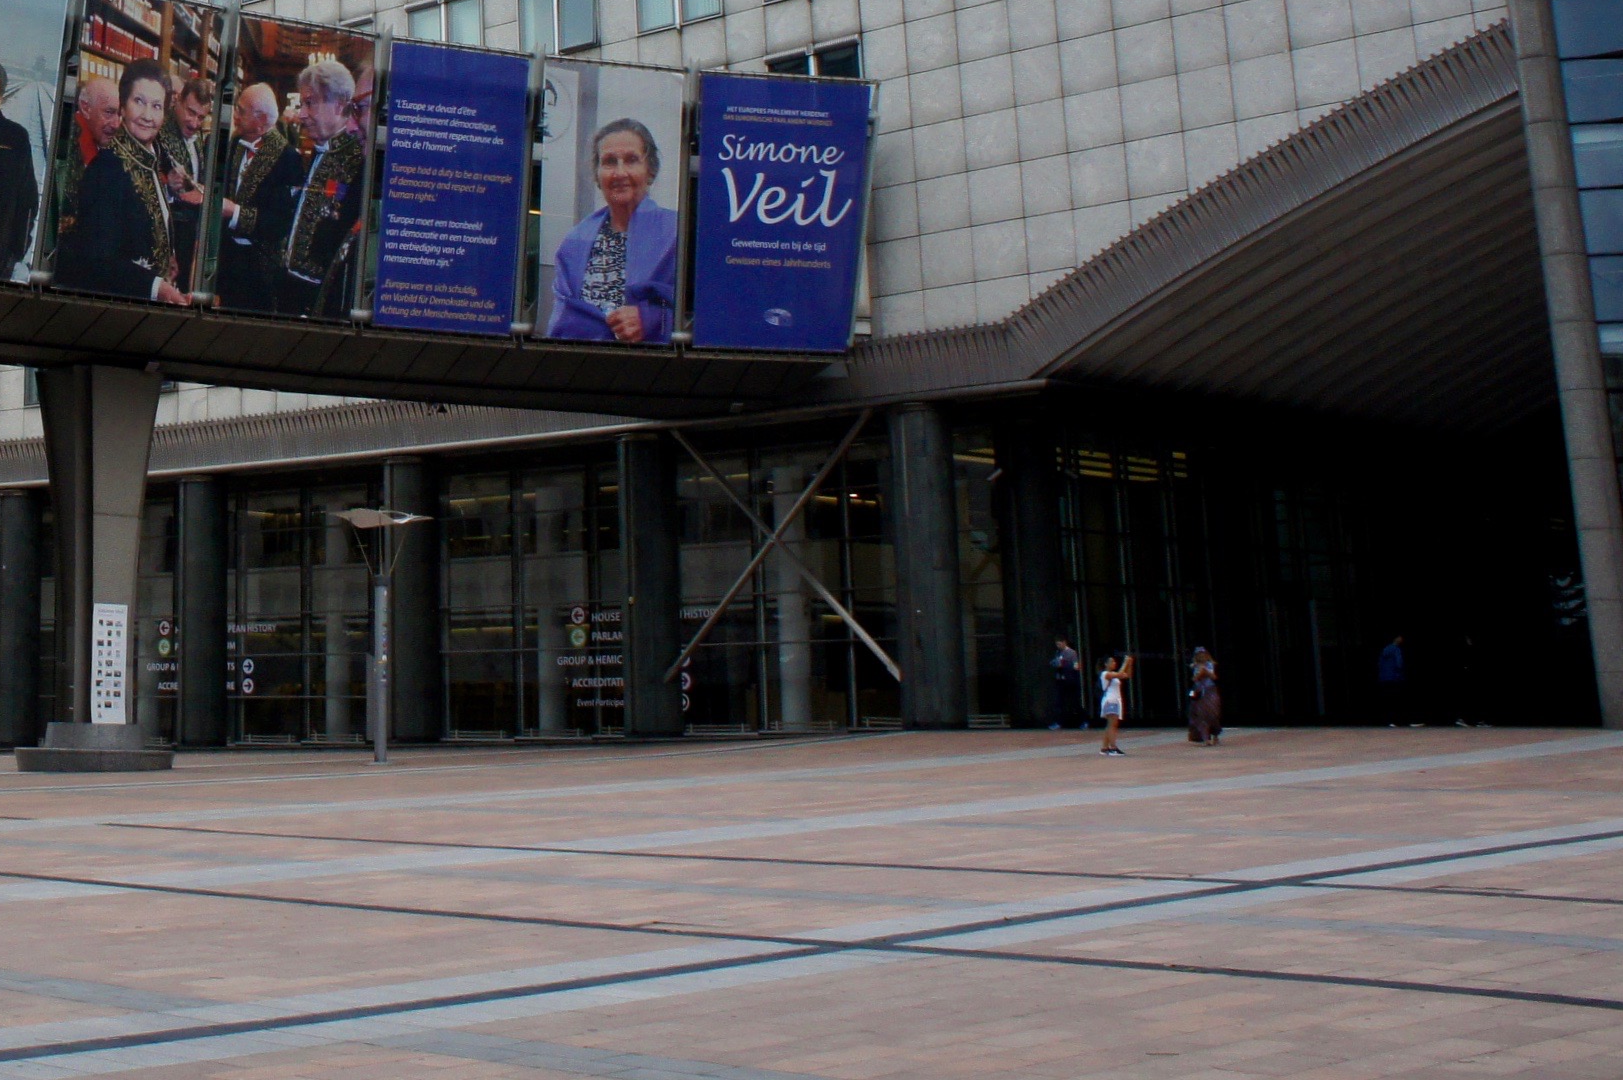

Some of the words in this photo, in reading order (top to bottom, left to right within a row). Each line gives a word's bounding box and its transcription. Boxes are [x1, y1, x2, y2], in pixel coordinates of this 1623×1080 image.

[435, 104, 456, 113] devait
[393, 114, 448, 125] exemplairement
[393, 127, 447, 138] exemplairement
[449, 133, 491, 143] respectueuse
[492, 137, 504, 145] des
[392, 139, 411, 148] droits
[412, 140, 421, 149] de
[718, 134, 845, 168] Simone
[417, 166, 432, 175] had
[438, 168, 454, 178] duty
[454, 170, 462, 178] to
[463, 170, 472, 179] be
[389, 176, 398, 184] of
[398, 177, 435, 189] democracy
[436, 182, 451, 190] and
[451, 184, 475, 192] respect
[388, 189, 414, 199] human
[721, 167, 853, 227] Veil
[415, 218, 434, 226] moet
[448, 221, 482, 230] toonbeeld
[400, 229, 438, 239] democratie
[463, 235, 496, 244] toonbeeld
[399, 243, 441, 254] eerbiediging
[455, 246, 465, 255] de
[731, 238, 780, 249] Gewetensvol
[780, 242, 791, 250] en
[791, 241, 802, 252] bij
[802, 242, 813, 251] de
[814, 242, 827, 253] tijd
[384, 255, 435, 265] mensenrechten
[725, 255, 761, 266] Gewissen
[762, 259, 782, 267] eines
[784, 259, 831, 269] Jahrhunderts
[434, 284, 447, 292] sich
[393, 293, 418, 302] Vorbild
[429, 296, 468, 306] Demokratie
[469, 300, 483, 308] und
[483, 300, 495, 309] die
[379, 305, 409, 317] Achtung
[410, 308, 422, 316] der
[591, 612, 621, 622] HOUSE
[246, 623, 277, 633] HISTORY
[557, 655, 586, 666] GROUP
[587, 655, 594, 665] &
[146, 663, 169, 671] GROUP
[577, 698, 594, 707] Event
